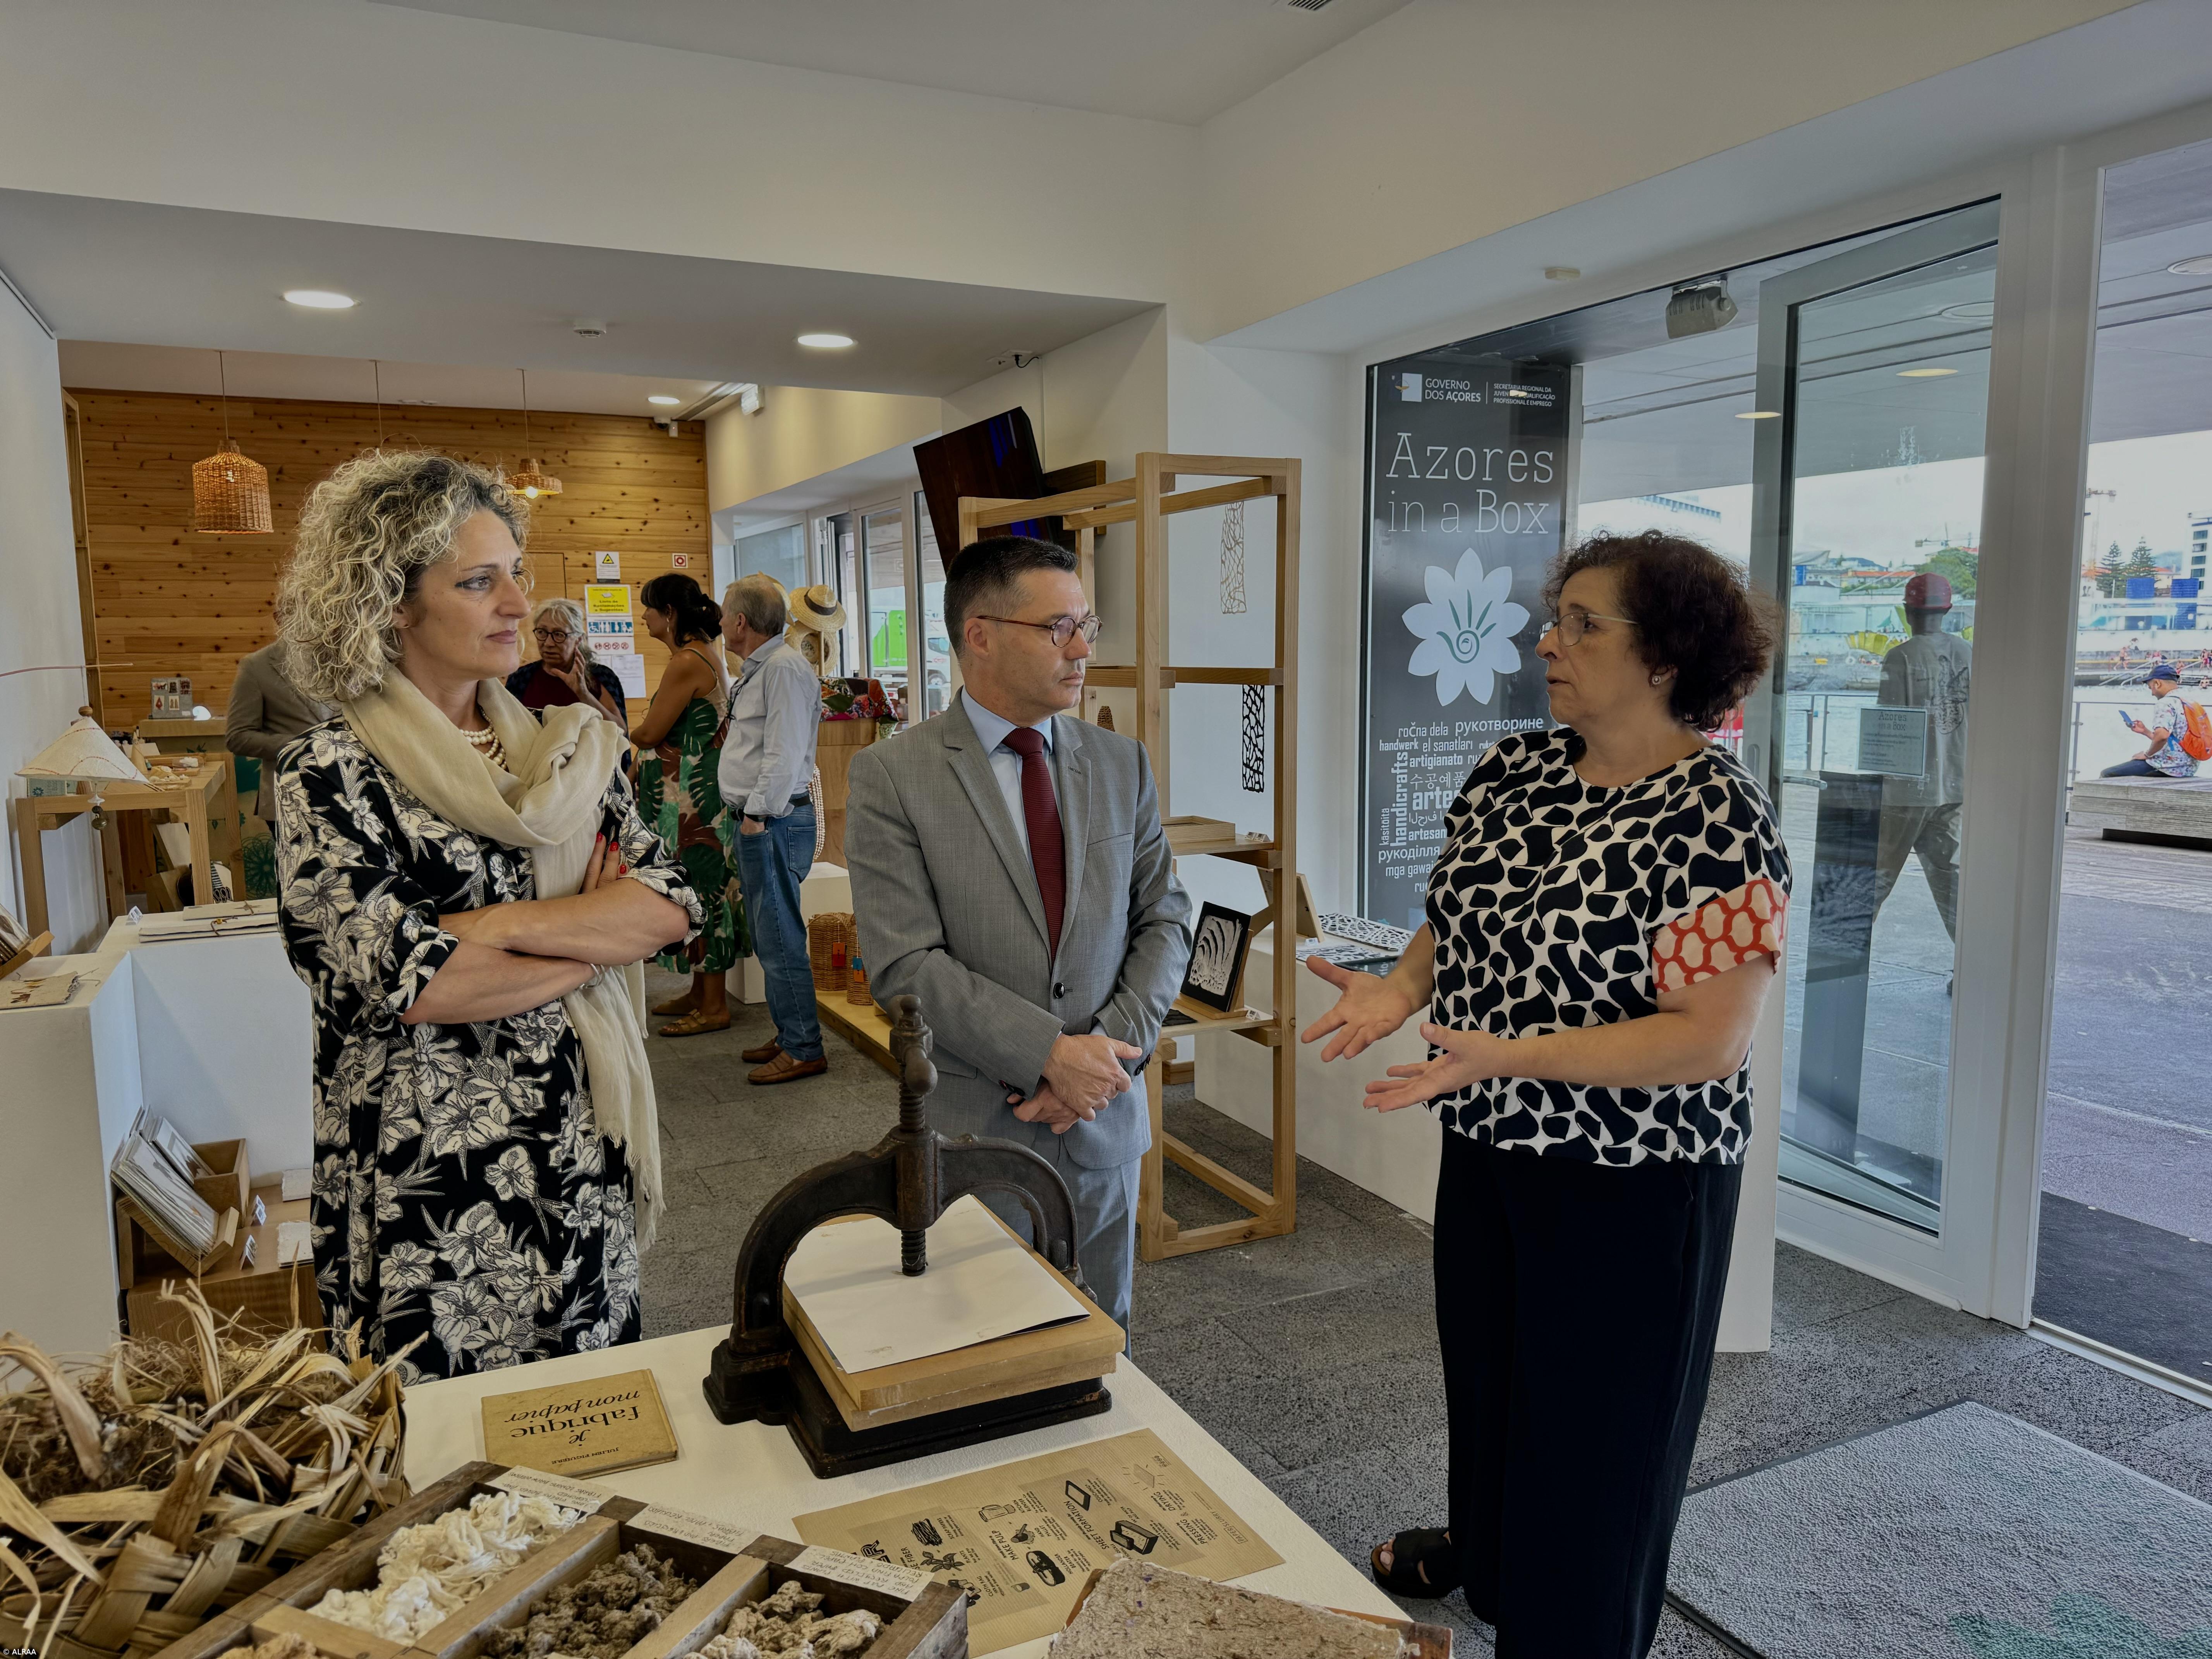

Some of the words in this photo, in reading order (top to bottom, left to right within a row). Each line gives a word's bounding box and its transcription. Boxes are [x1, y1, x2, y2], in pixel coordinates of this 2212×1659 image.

[1425, 378, 1470, 390] GOVERNO
[1425, 390, 1444, 400] DOS
[1446, 392, 1481, 403] AÇORES
[1386, 432, 1553, 483] Azores
[1388, 490, 1427, 532] in
[1441, 502, 1462, 532] a
[1475, 489, 1548, 534] Box
[1879, 711, 1906, 721] Azores
[1398, 722, 1426, 737] ročna
[1430, 721, 1448, 736] dela
[1455, 718, 1543, 737] рукотворине
[1893, 722, 1905, 731] Box
[1379, 738, 1419, 751] handwerk
[1423, 738, 1430, 751] el
[1410, 754, 1463, 769] artigianato
[1410, 771, 1466, 790] 수공예품
[1390, 752, 1408, 847] handicrafts
[1379, 808, 1389, 846] käsitöitä
[1379, 846, 1440, 864] рукоділля
[1386, 866, 1405, 879] mga
[586, 1390, 640, 1408] mon
[504, 1398, 584, 1422] papier
[510, 1405, 641, 1438] fabrique
[569, 1429, 591, 1446] je
[592, 1447, 619, 1457] JULIEN
[1012, 1499, 1025, 1513] KITCHEN
[1018, 1498, 1032, 1511] BLENDER
[1152, 1491, 1176, 1511] DRYING
[1063, 1500, 1094, 1532] FORMATION
[1120, 1506, 1130, 1514] WATER
[1209, 1510, 1230, 1527] SLURRY
[943, 1528, 955, 1539] SCRAP
[991, 1529, 1007, 1543] PULP
[1033, 1527, 1045, 1537] HAND
[1038, 1525, 1051, 1537] MALLET
[1179, 1518, 1208, 1544] PRESSING
[1226, 1527, 1245, 1541] PAPER
[1090, 1532, 1110, 1549] SHEET
[899, 1547, 915, 1562] FIBER
[958, 1550, 970, 1563] PLANTS
[1001, 1544, 1020, 1560] MAKE
[1053, 1553, 1073, 1574] HOLLANDER
[1063, 1556, 1076, 1568] BEATER
[976, 1575, 986, 1583] RAG
[981, 1583, 994, 1596] CLOTH
